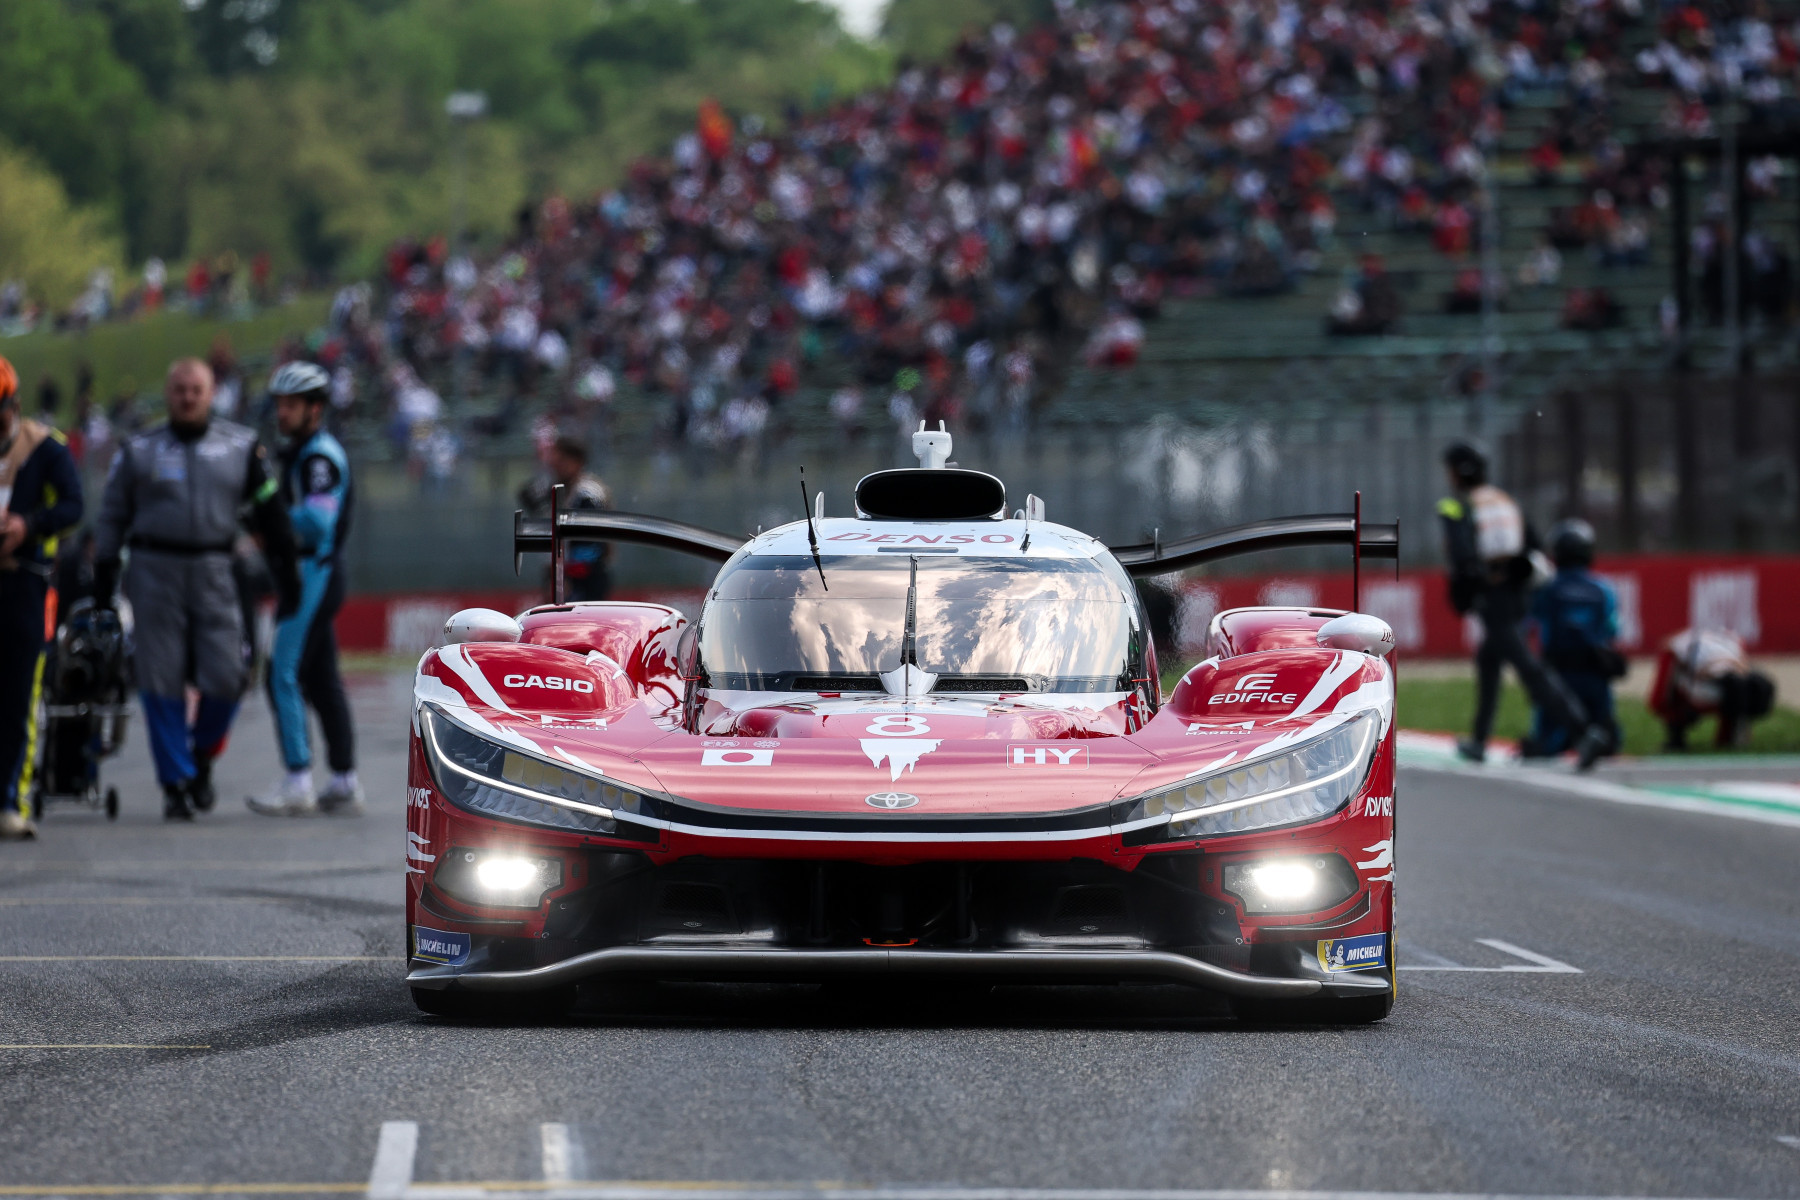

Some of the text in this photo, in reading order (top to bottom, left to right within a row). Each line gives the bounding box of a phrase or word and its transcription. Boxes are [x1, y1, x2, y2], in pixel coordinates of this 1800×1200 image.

[825, 532, 1015, 544] DENSO
[503, 674, 594, 694] CASIO
[1207, 692, 1298, 705] EDIFICE
[865, 714, 931, 737] 8
[1013, 747, 1082, 765] HY
[1347, 945, 1383, 961] MICHELIN
